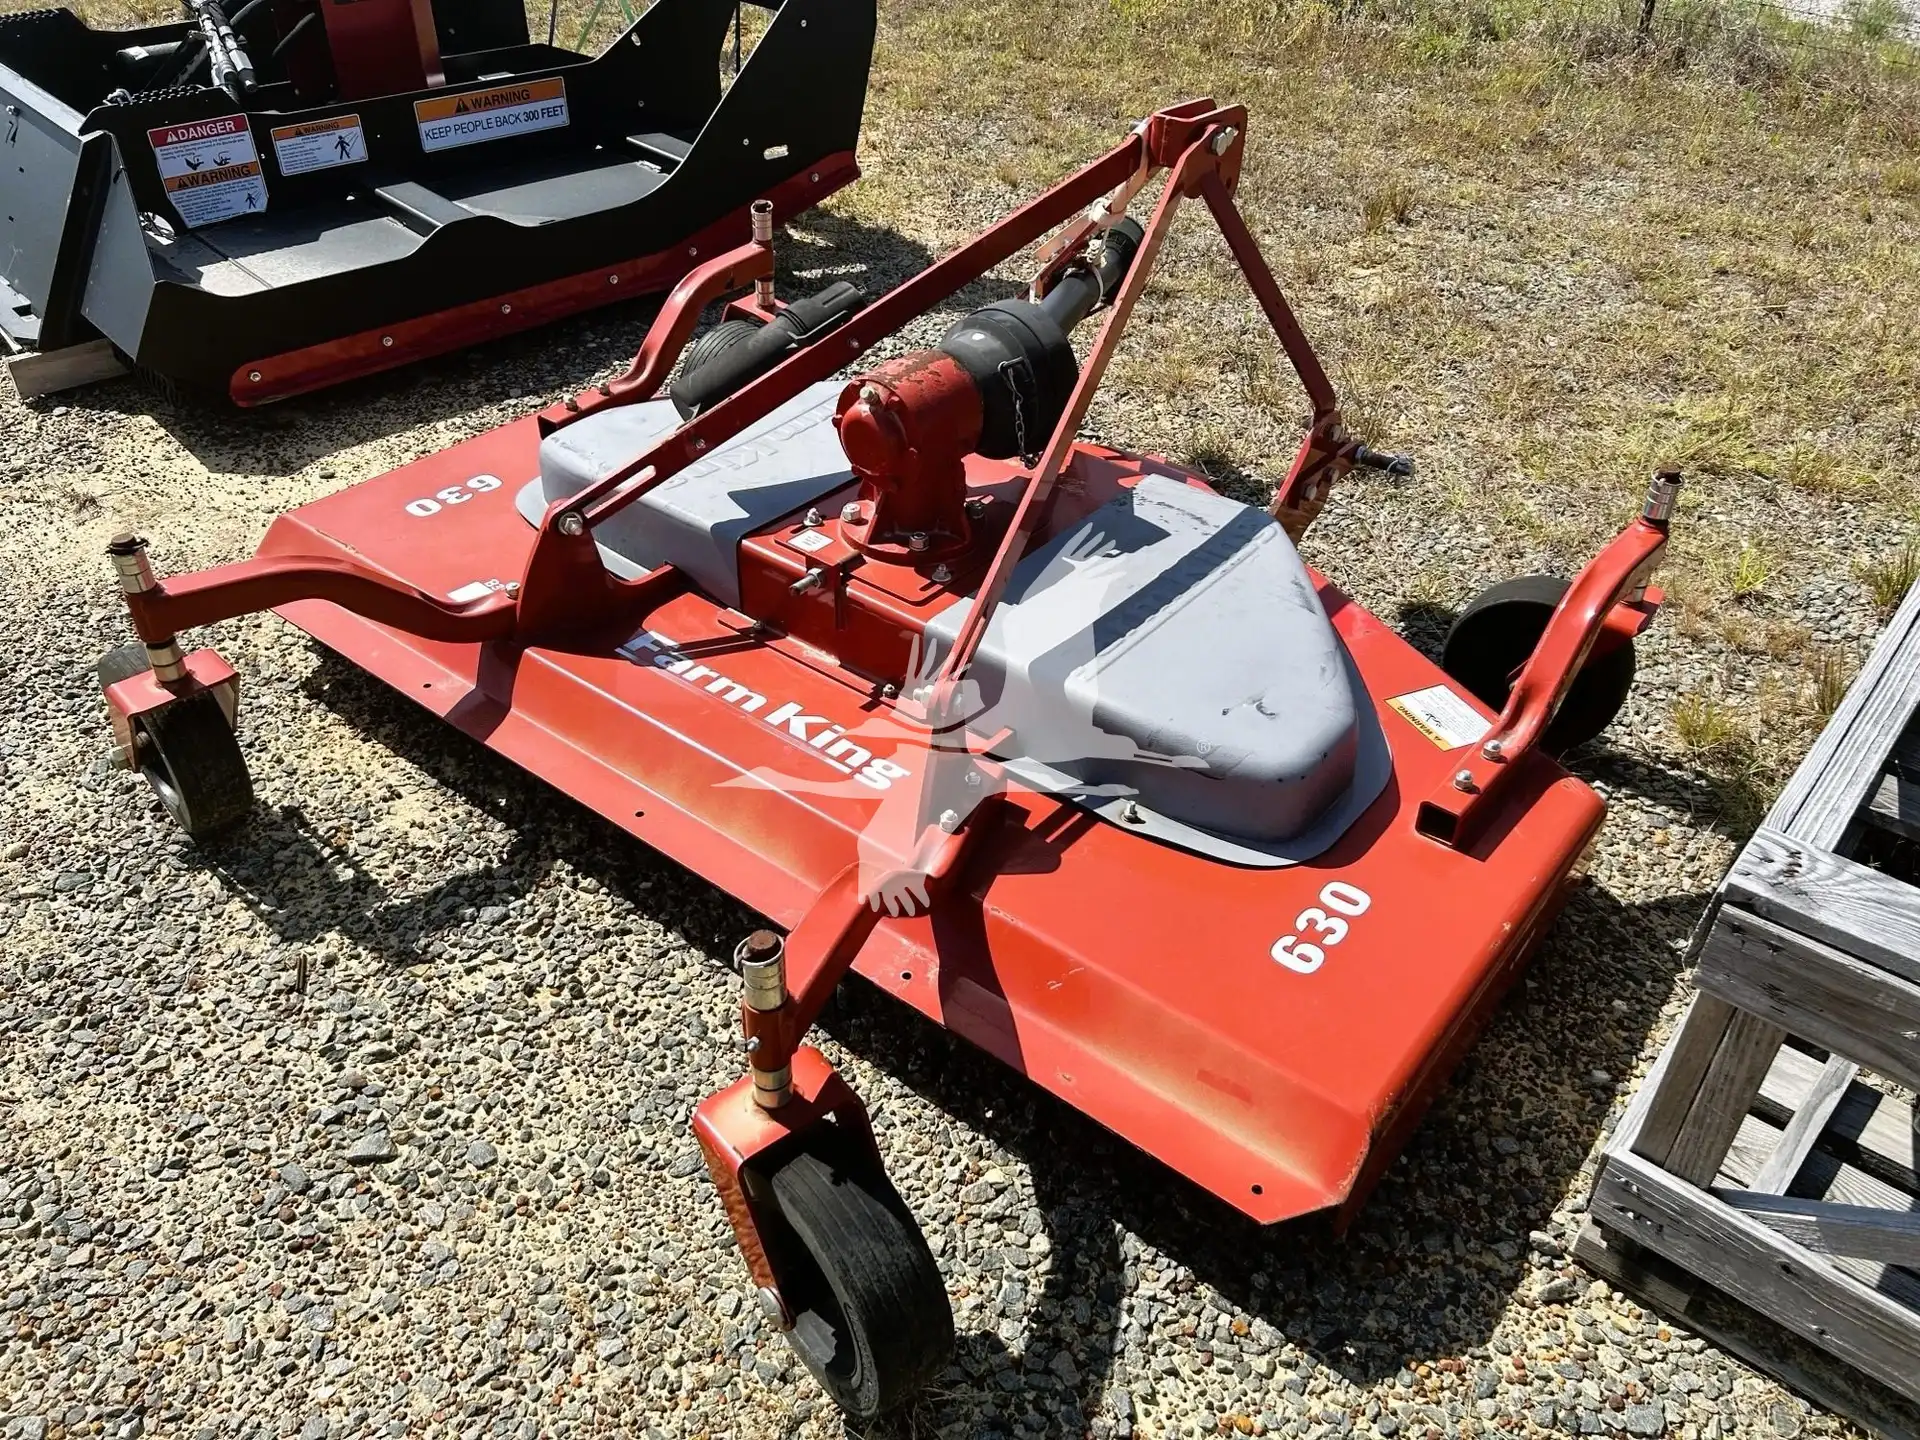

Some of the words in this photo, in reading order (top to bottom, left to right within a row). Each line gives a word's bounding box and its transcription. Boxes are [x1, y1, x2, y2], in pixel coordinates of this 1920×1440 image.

[470, 89, 531, 110] WARNING
[178, 120, 236, 141] DANGER
[303, 122, 340, 135] WARNING
[424, 126, 451, 141] KEEP
[454, 117, 494, 136] PEOPLE
[495, 112, 523, 128] BACK
[523, 109, 540, 123] 300
[541, 104, 565, 119] FEET
[187, 165, 251, 187] WARNING
[404, 473, 503, 518] 630
[622, 629, 768, 713] Farm
[763, 701, 913, 790] King
[1397, 705, 1433, 736] WARNING
[1269, 880, 1372, 975] 630
